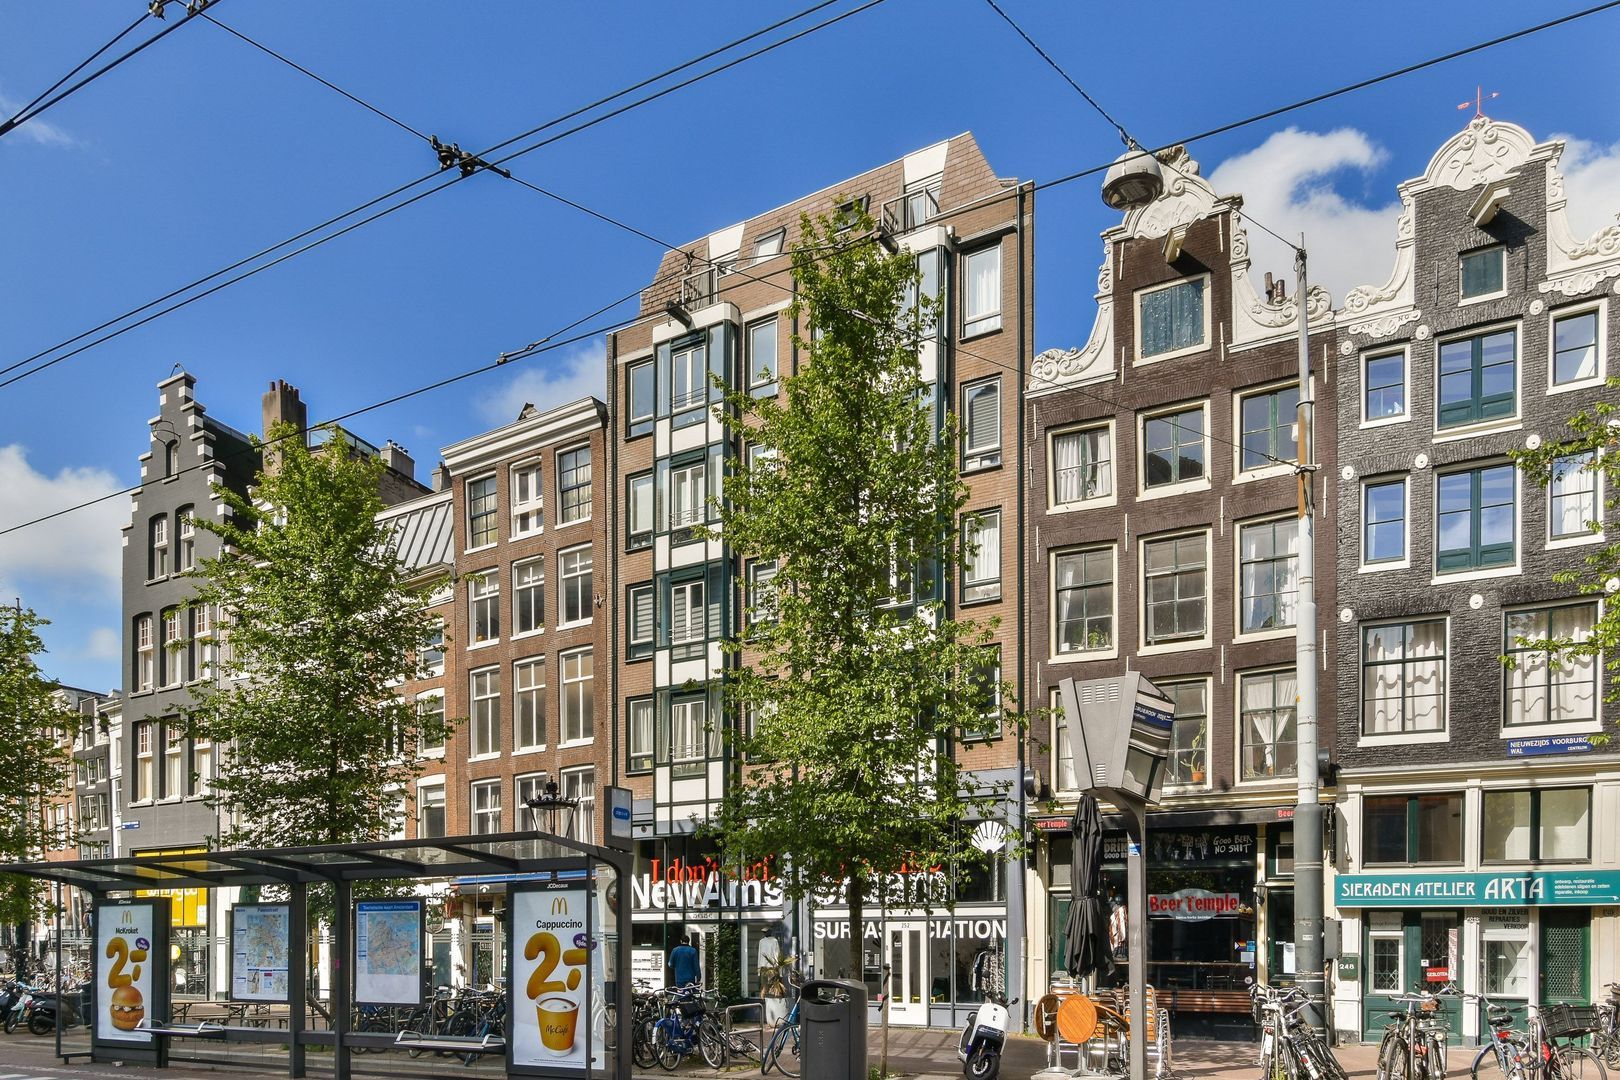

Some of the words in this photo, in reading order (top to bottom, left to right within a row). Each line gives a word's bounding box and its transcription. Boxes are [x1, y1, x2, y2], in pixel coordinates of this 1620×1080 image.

[1510, 739, 1549, 748] NIEUWEZIJDS
[1047, 820, 1067, 828] Temple
[1104, 843, 1127, 852] DRIN
[1214, 845, 1225, 854] NO
[1228, 844, 1250, 853] SHIT
[1341, 882, 1411, 896] SIERADEN
[1414, 882, 1476, 896] ATELIER
[1484, 877, 1544, 899] ARTA
[1150, 896, 1183, 912] Beer
[1185, 893, 1238, 913] Temple
[536, 919, 583, 930] Cappuccino
[545, 1024, 568, 1036] McCafé
